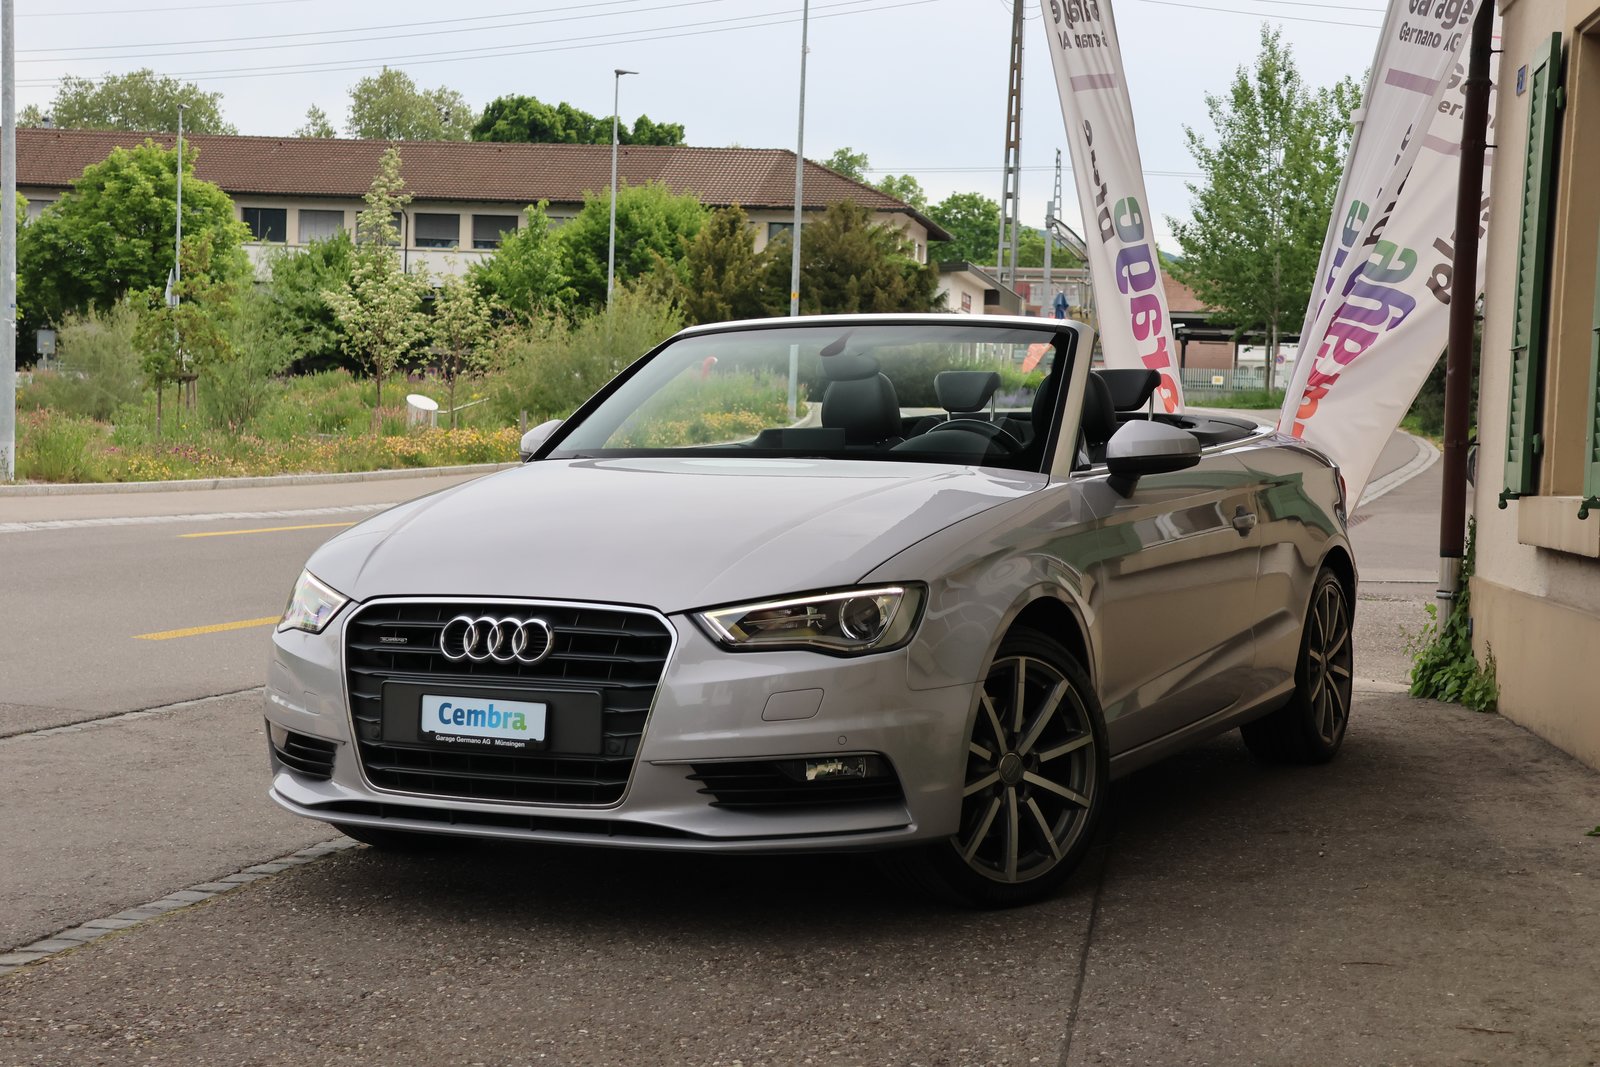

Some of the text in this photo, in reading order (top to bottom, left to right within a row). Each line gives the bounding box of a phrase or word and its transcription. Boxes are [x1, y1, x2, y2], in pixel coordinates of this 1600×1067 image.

[438, 702, 527, 731] Cembra
[435, 734, 455, 743] Garage
[456, 736, 481, 744] Germano
[494, 739, 525, 748] Münsingen
